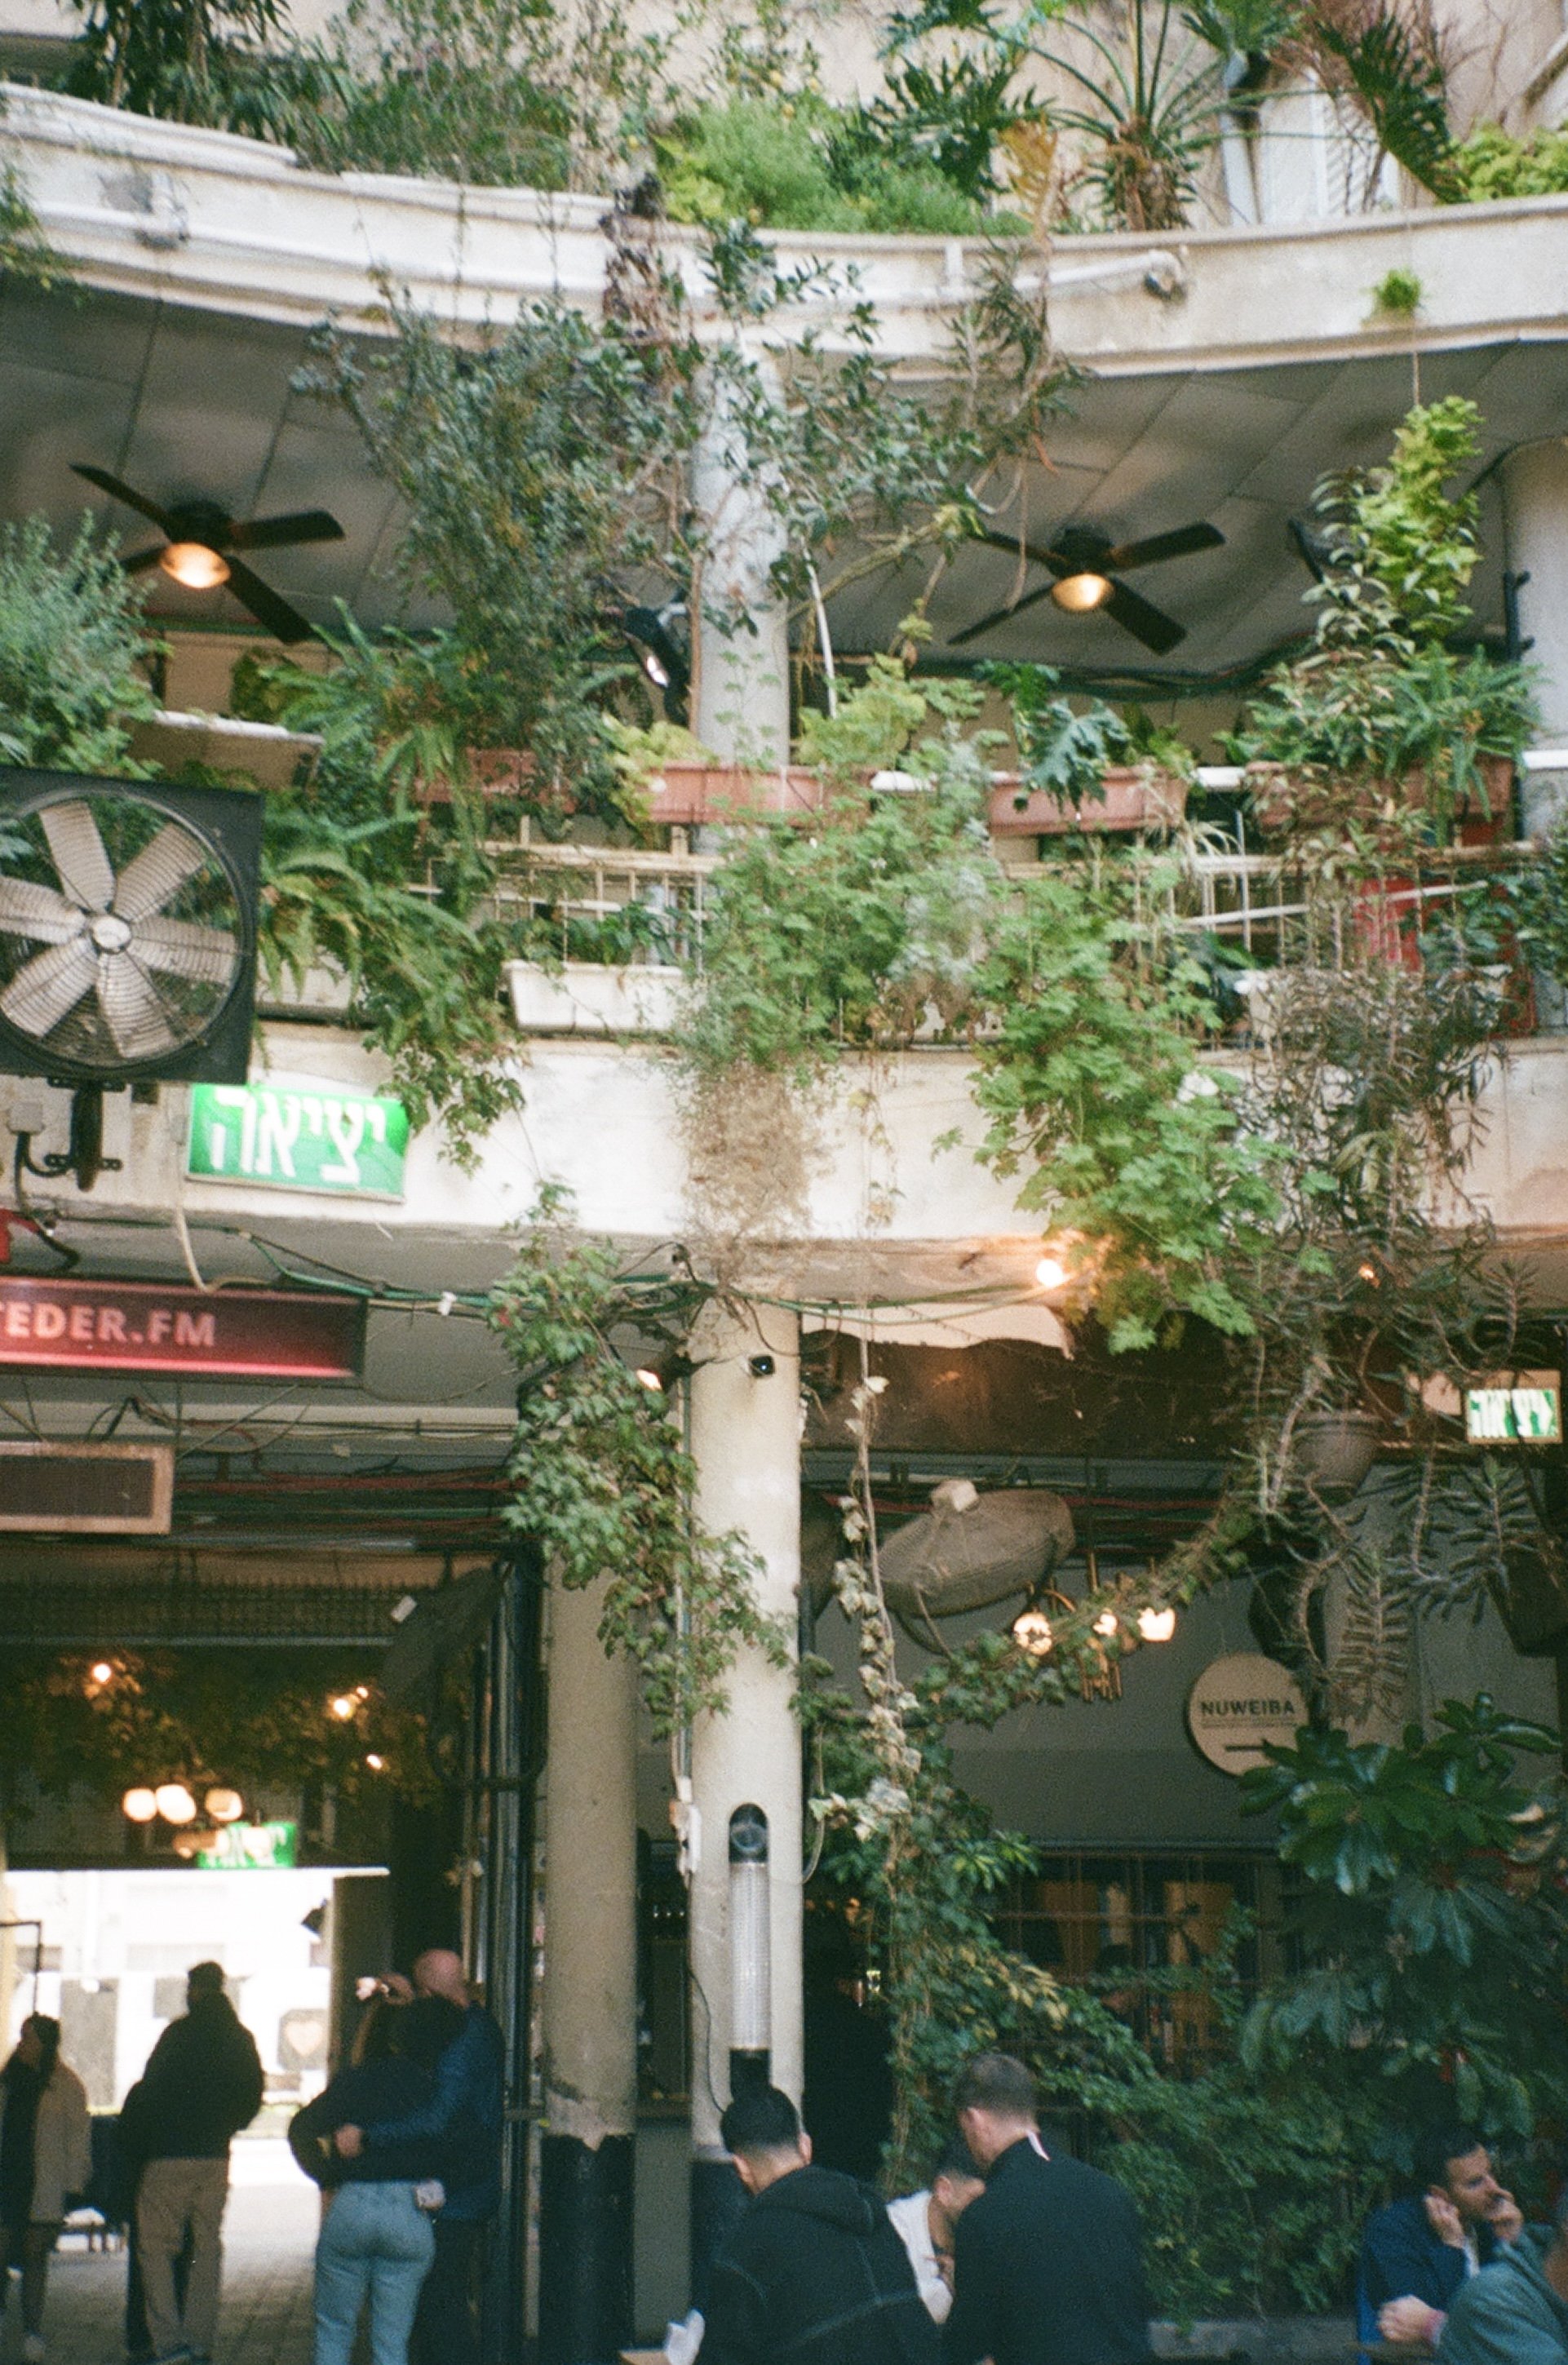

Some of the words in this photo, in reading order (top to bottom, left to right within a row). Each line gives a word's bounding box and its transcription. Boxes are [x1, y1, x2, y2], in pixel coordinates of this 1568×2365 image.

[209, 1086, 387, 1183] יציאה
[0, 1301, 216, 1347] EDER.FM
[1200, 1699, 1296, 1715] NUWEIBA
